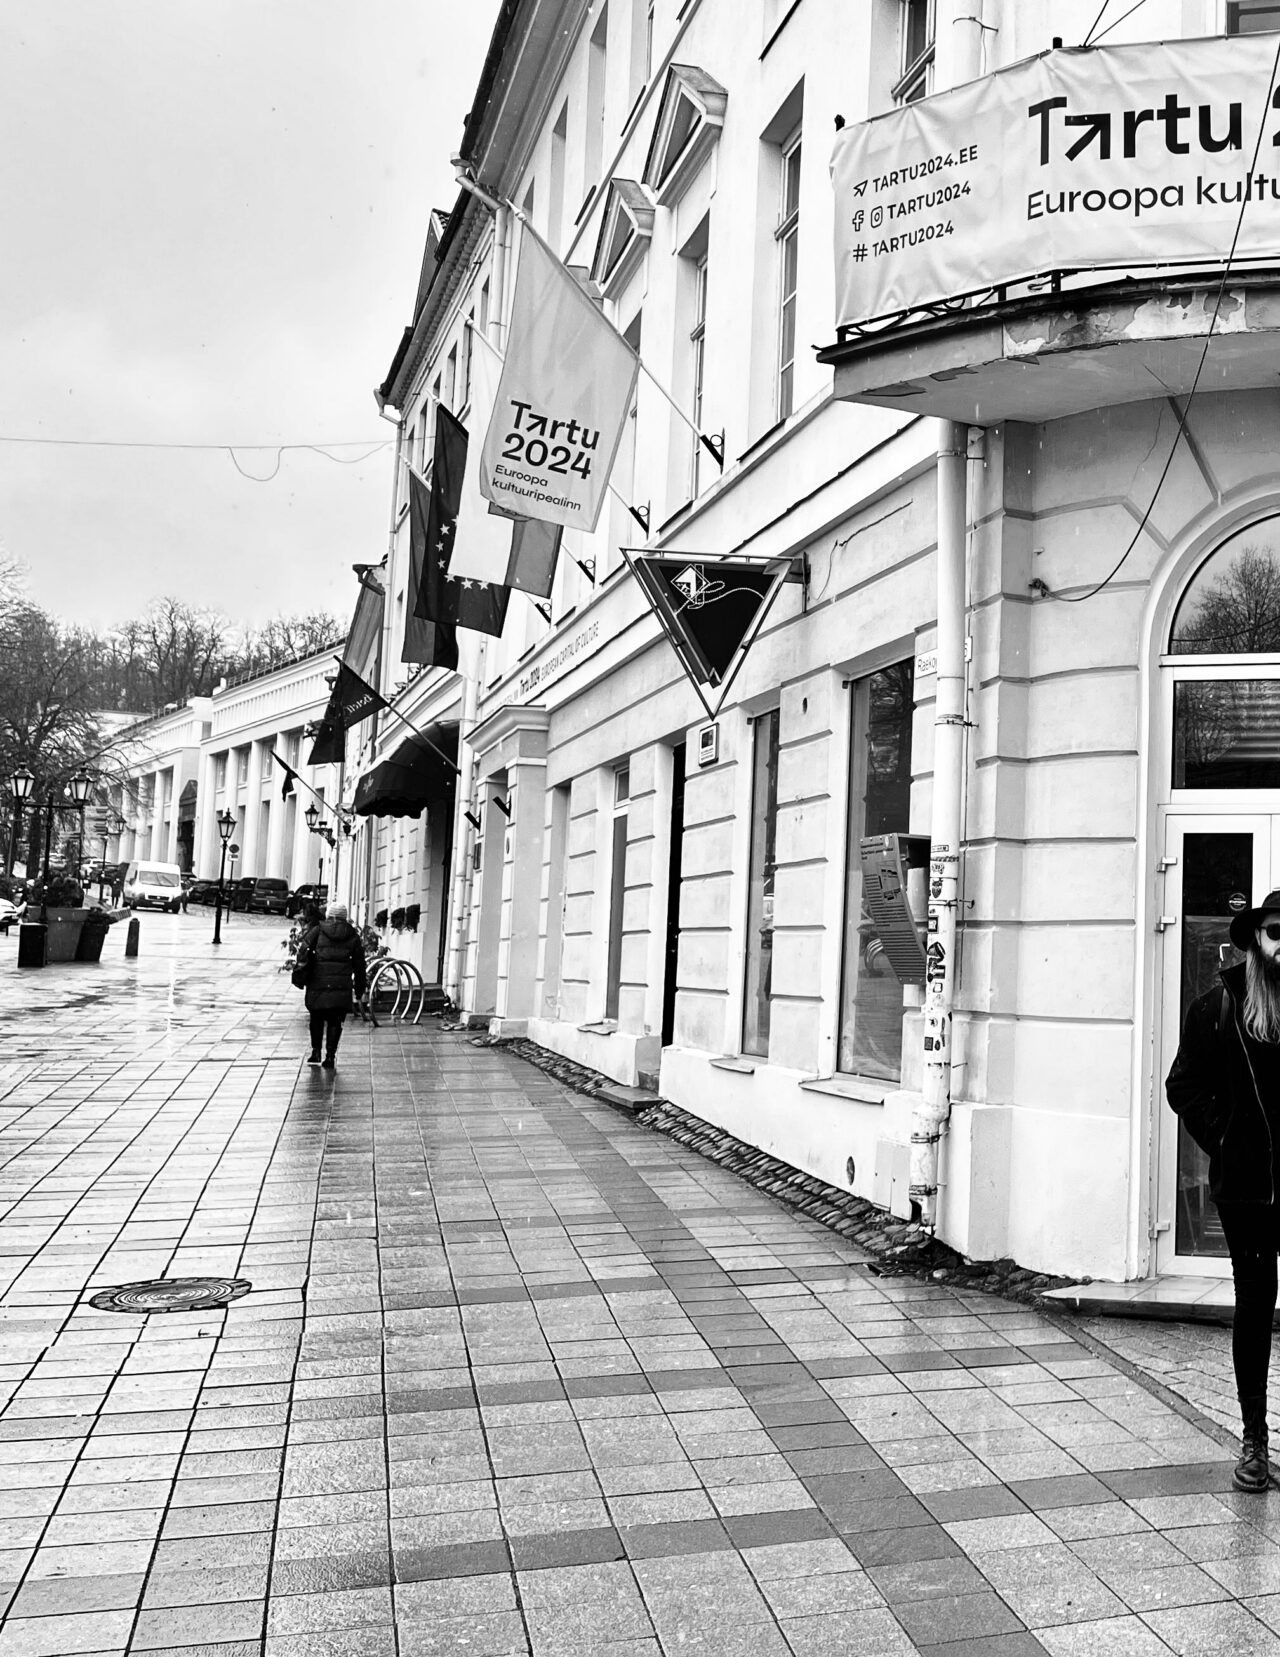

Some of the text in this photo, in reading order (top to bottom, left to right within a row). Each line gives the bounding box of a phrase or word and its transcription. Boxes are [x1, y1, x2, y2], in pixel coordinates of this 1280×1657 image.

[872, 144, 978, 193] TARTU2024.EE
[887, 181, 972, 220] TARTU2024
[1027, 184, 1184, 221] Euroopa
[501, 432, 591, 480] 2024
[491, 477, 582, 511] kultuuripealinn
[495, 464, 548, 487] Euroopa
